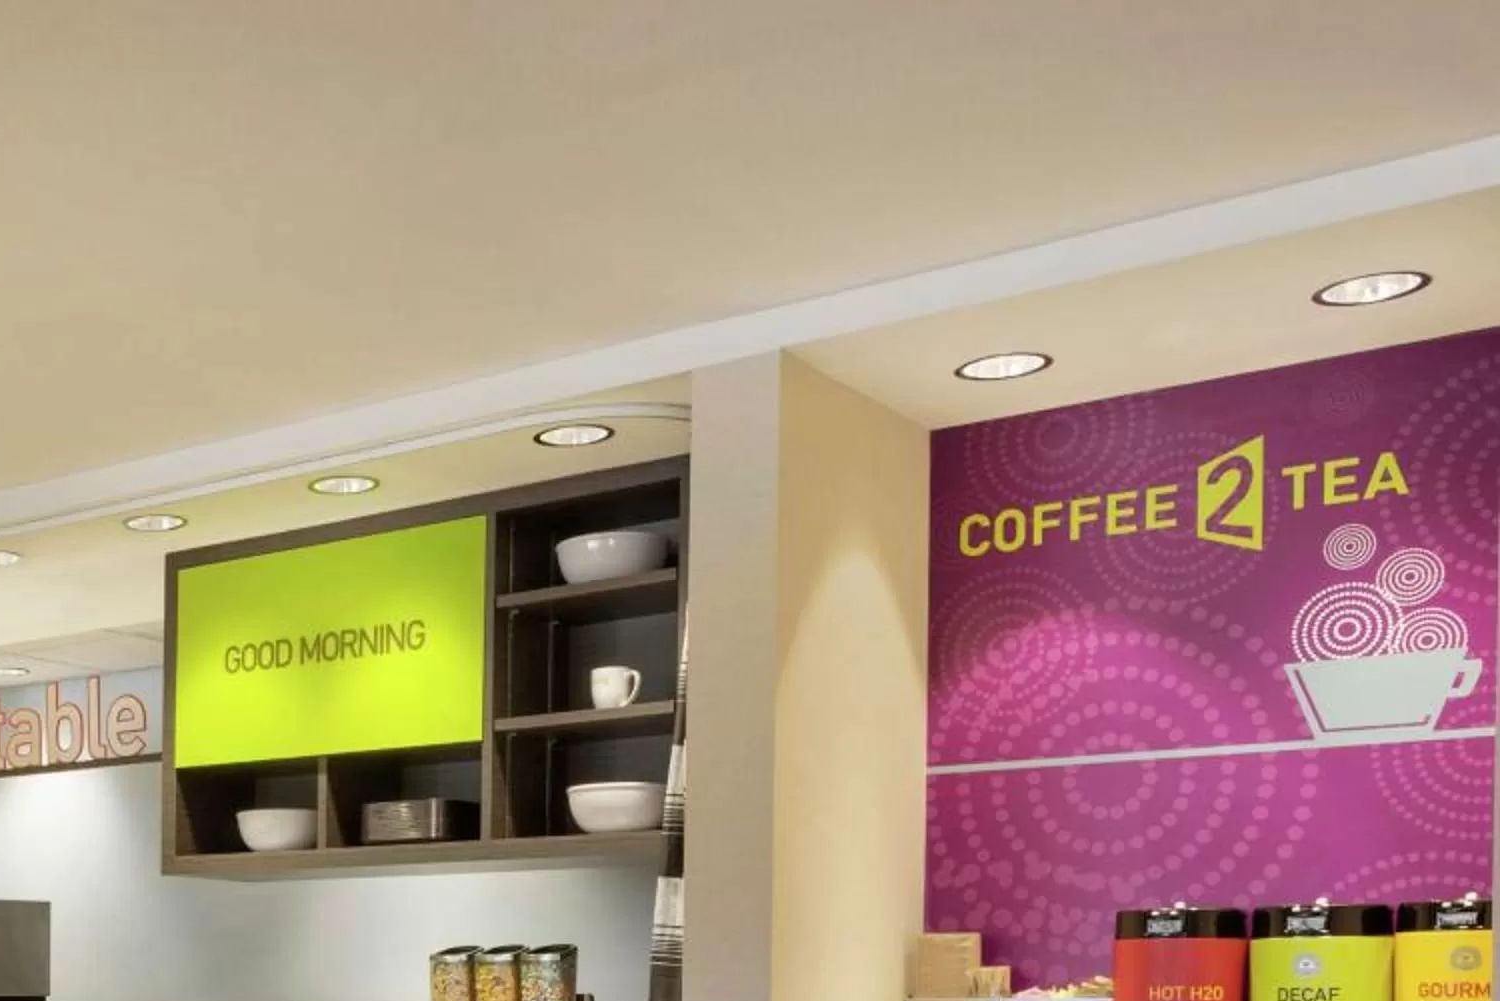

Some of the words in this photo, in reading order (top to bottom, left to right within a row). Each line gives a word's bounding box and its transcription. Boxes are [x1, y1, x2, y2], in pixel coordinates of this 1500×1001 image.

[958, 484, 1180, 557] COFFEE
[1206, 454, 1254, 537] 2
[1282, 451, 1410, 510] TEA
[225, 638, 293, 674] GOOD
[300, 619, 426, 665] MORNING
[1417, 981, 1492, 999] GOURM
